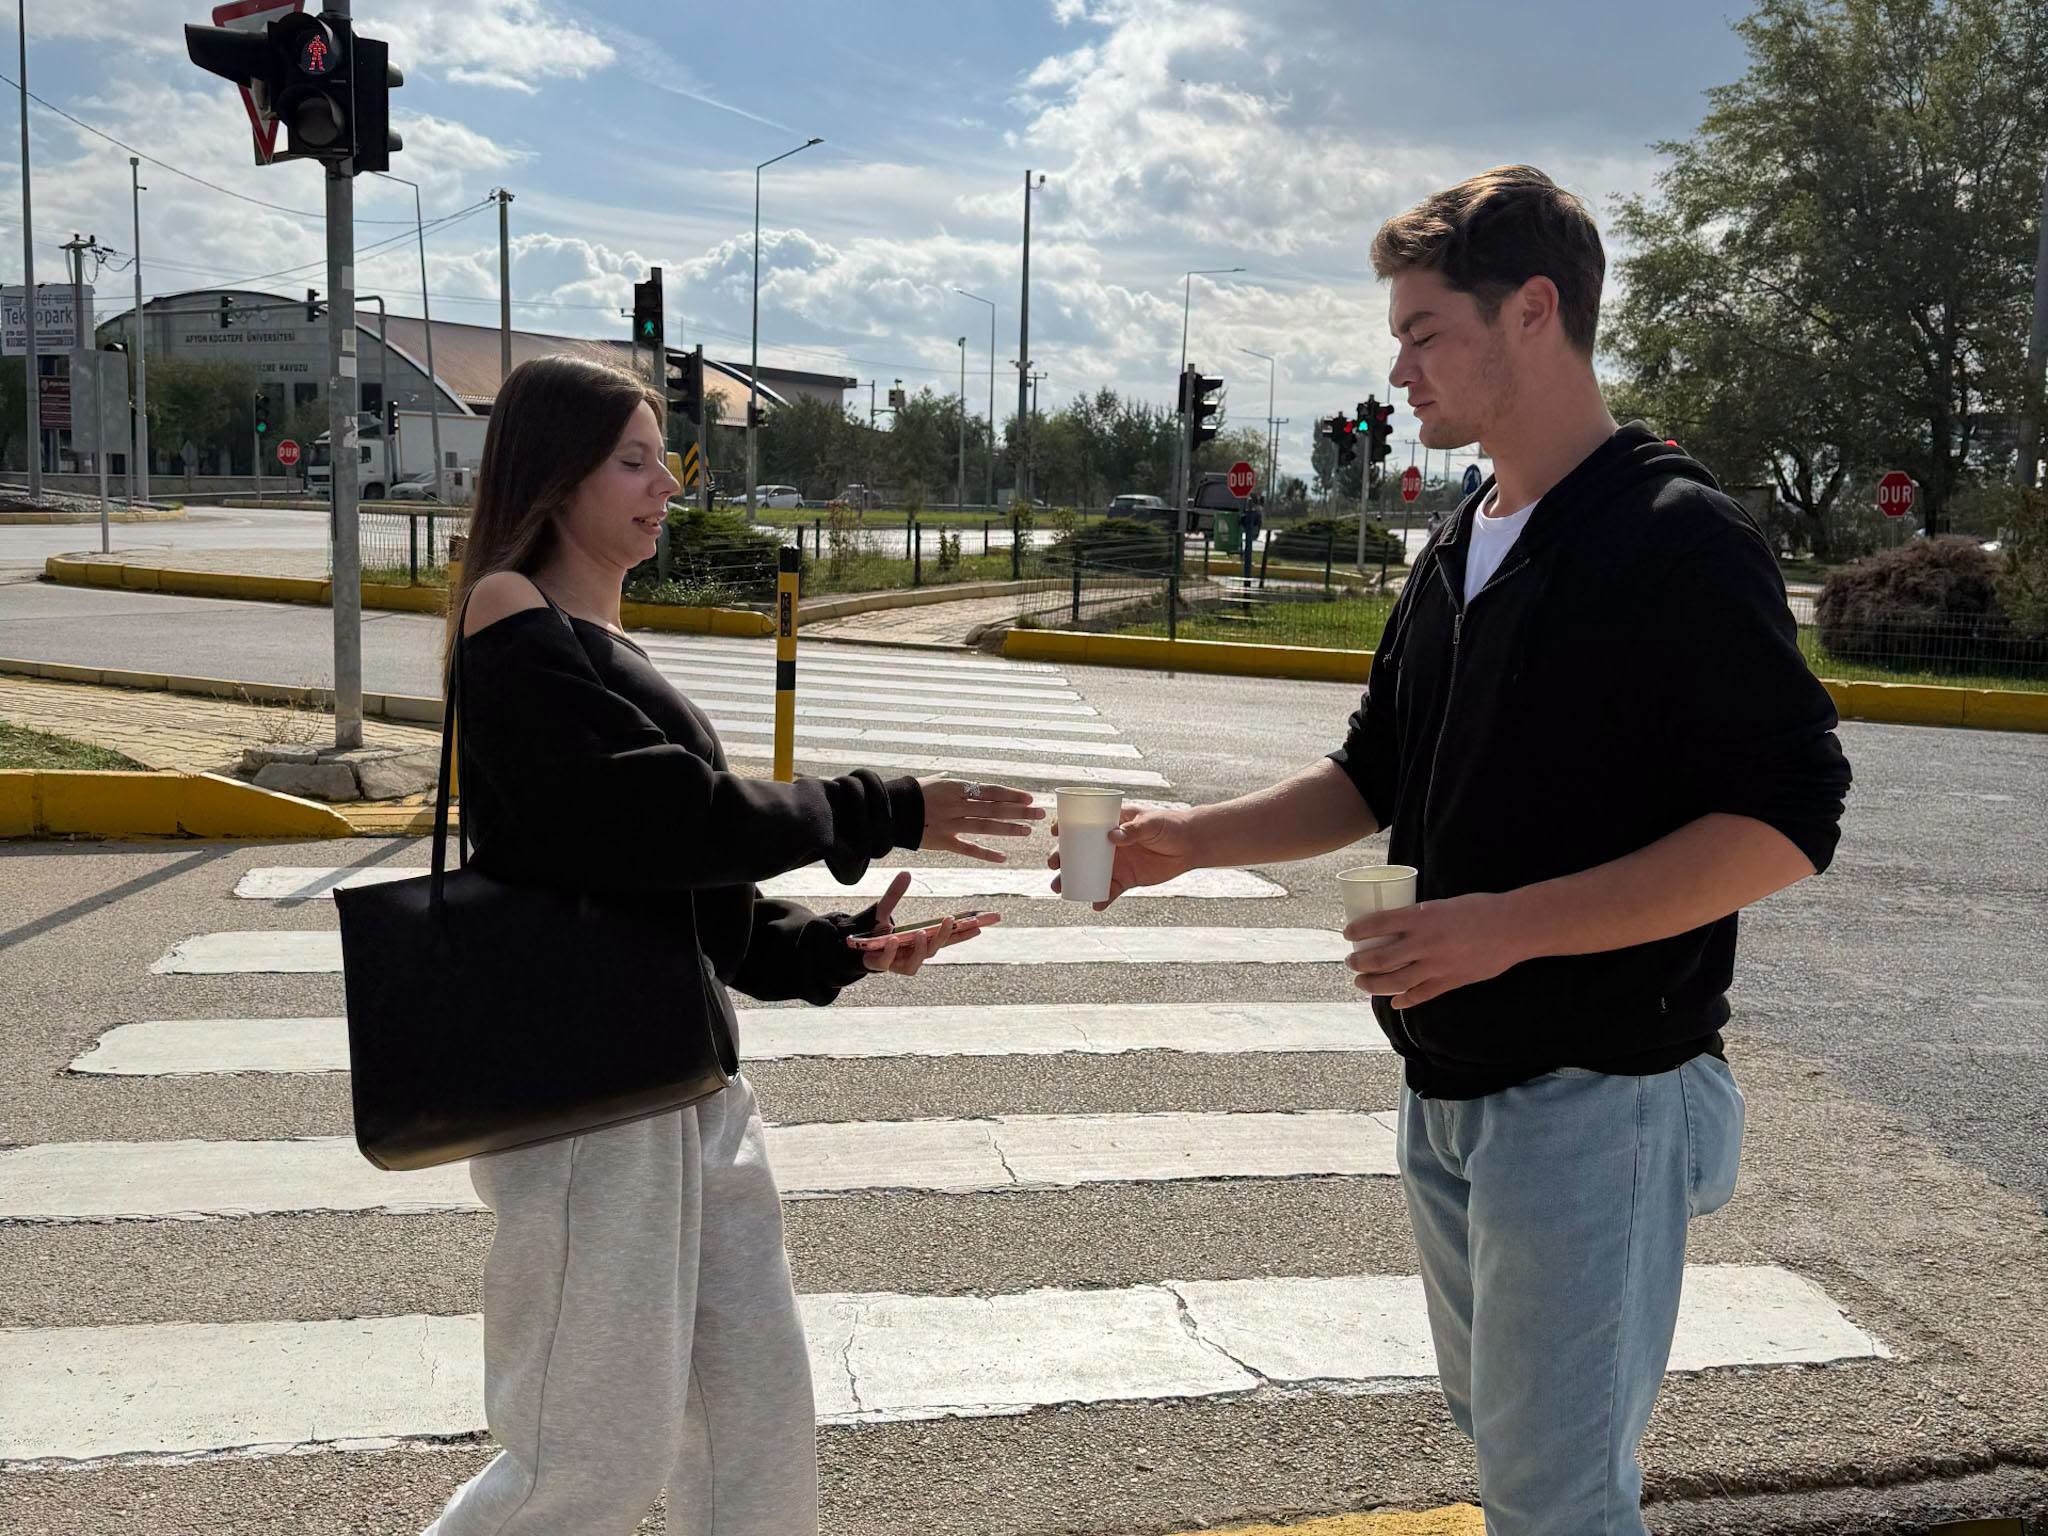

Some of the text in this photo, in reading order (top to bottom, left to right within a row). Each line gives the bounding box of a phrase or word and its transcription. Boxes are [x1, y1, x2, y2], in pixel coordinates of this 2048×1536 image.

[5, 305, 73, 328] Tekopark
[185, 334, 208, 343] AFYON
[209, 333, 243, 343] KOCATEPE
[279, 446, 298, 457] DUR
[1230, 471, 1253, 487] DUR
[1402, 477, 1420, 491] DUR
[1880, 486, 1911, 503] DUR
